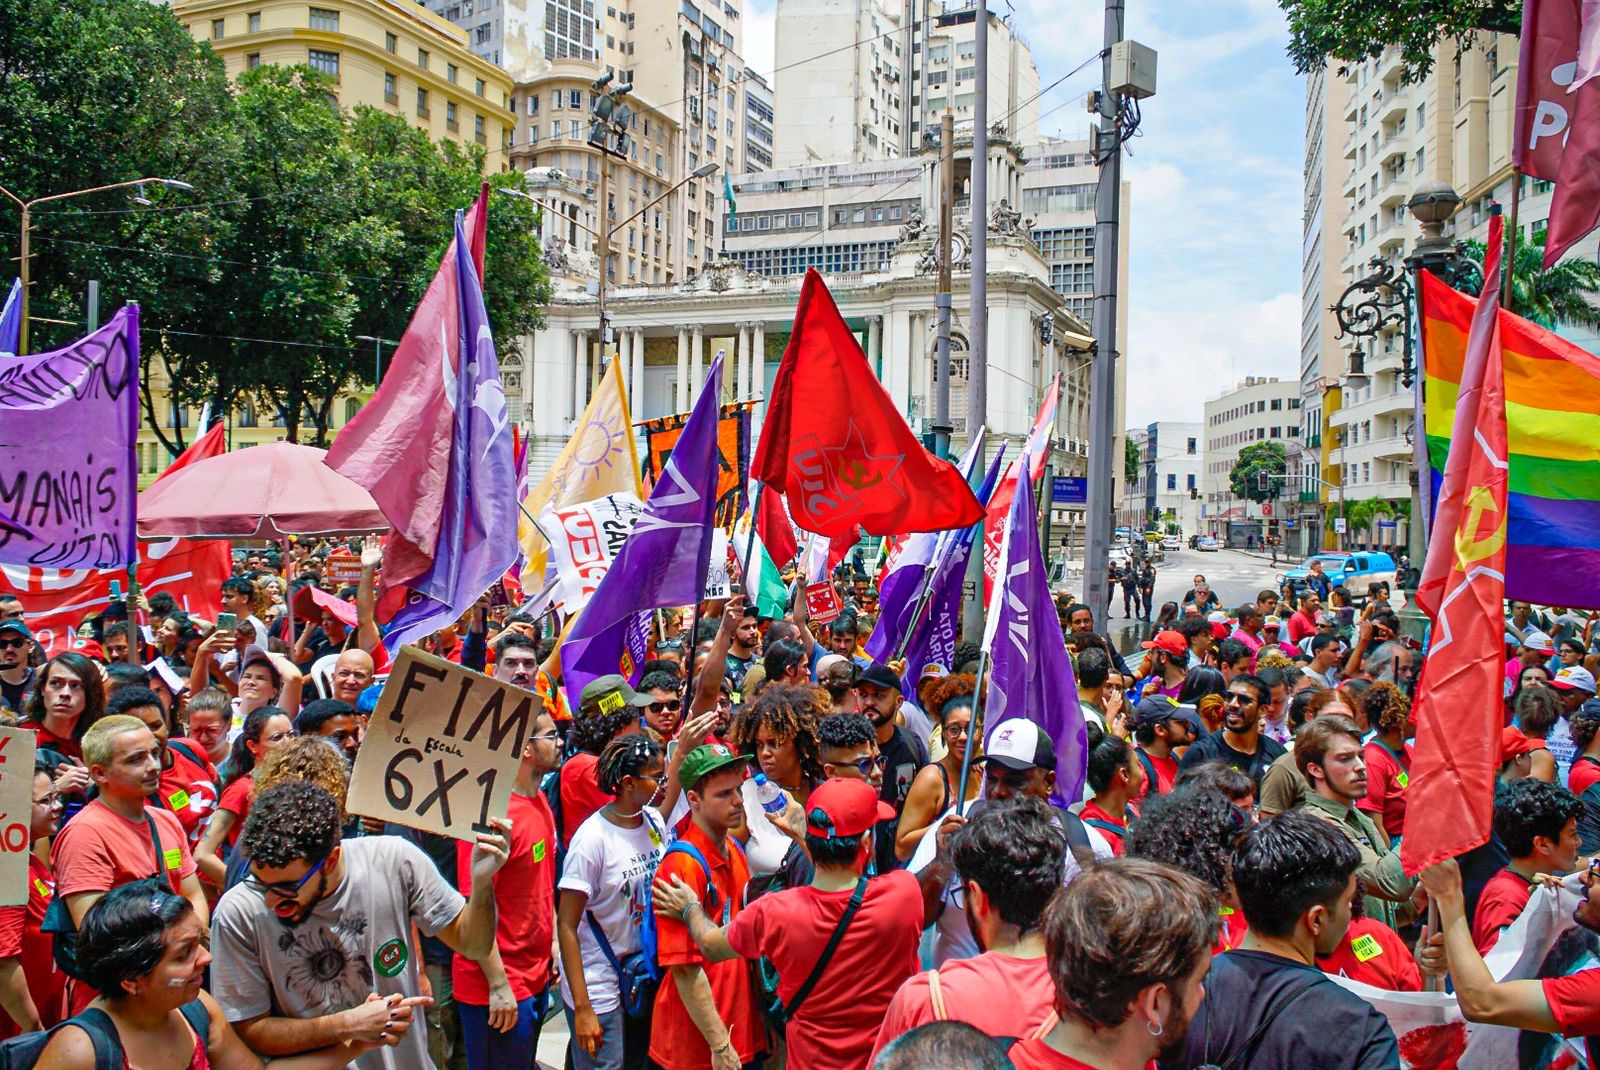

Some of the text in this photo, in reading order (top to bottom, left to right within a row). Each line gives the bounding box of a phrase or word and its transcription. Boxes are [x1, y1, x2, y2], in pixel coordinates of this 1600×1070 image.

[1529, 100, 1570, 150] P
[389, 661, 532, 759] FIM
[395, 728, 411, 744] da
[650, 849, 660, 859] AO
